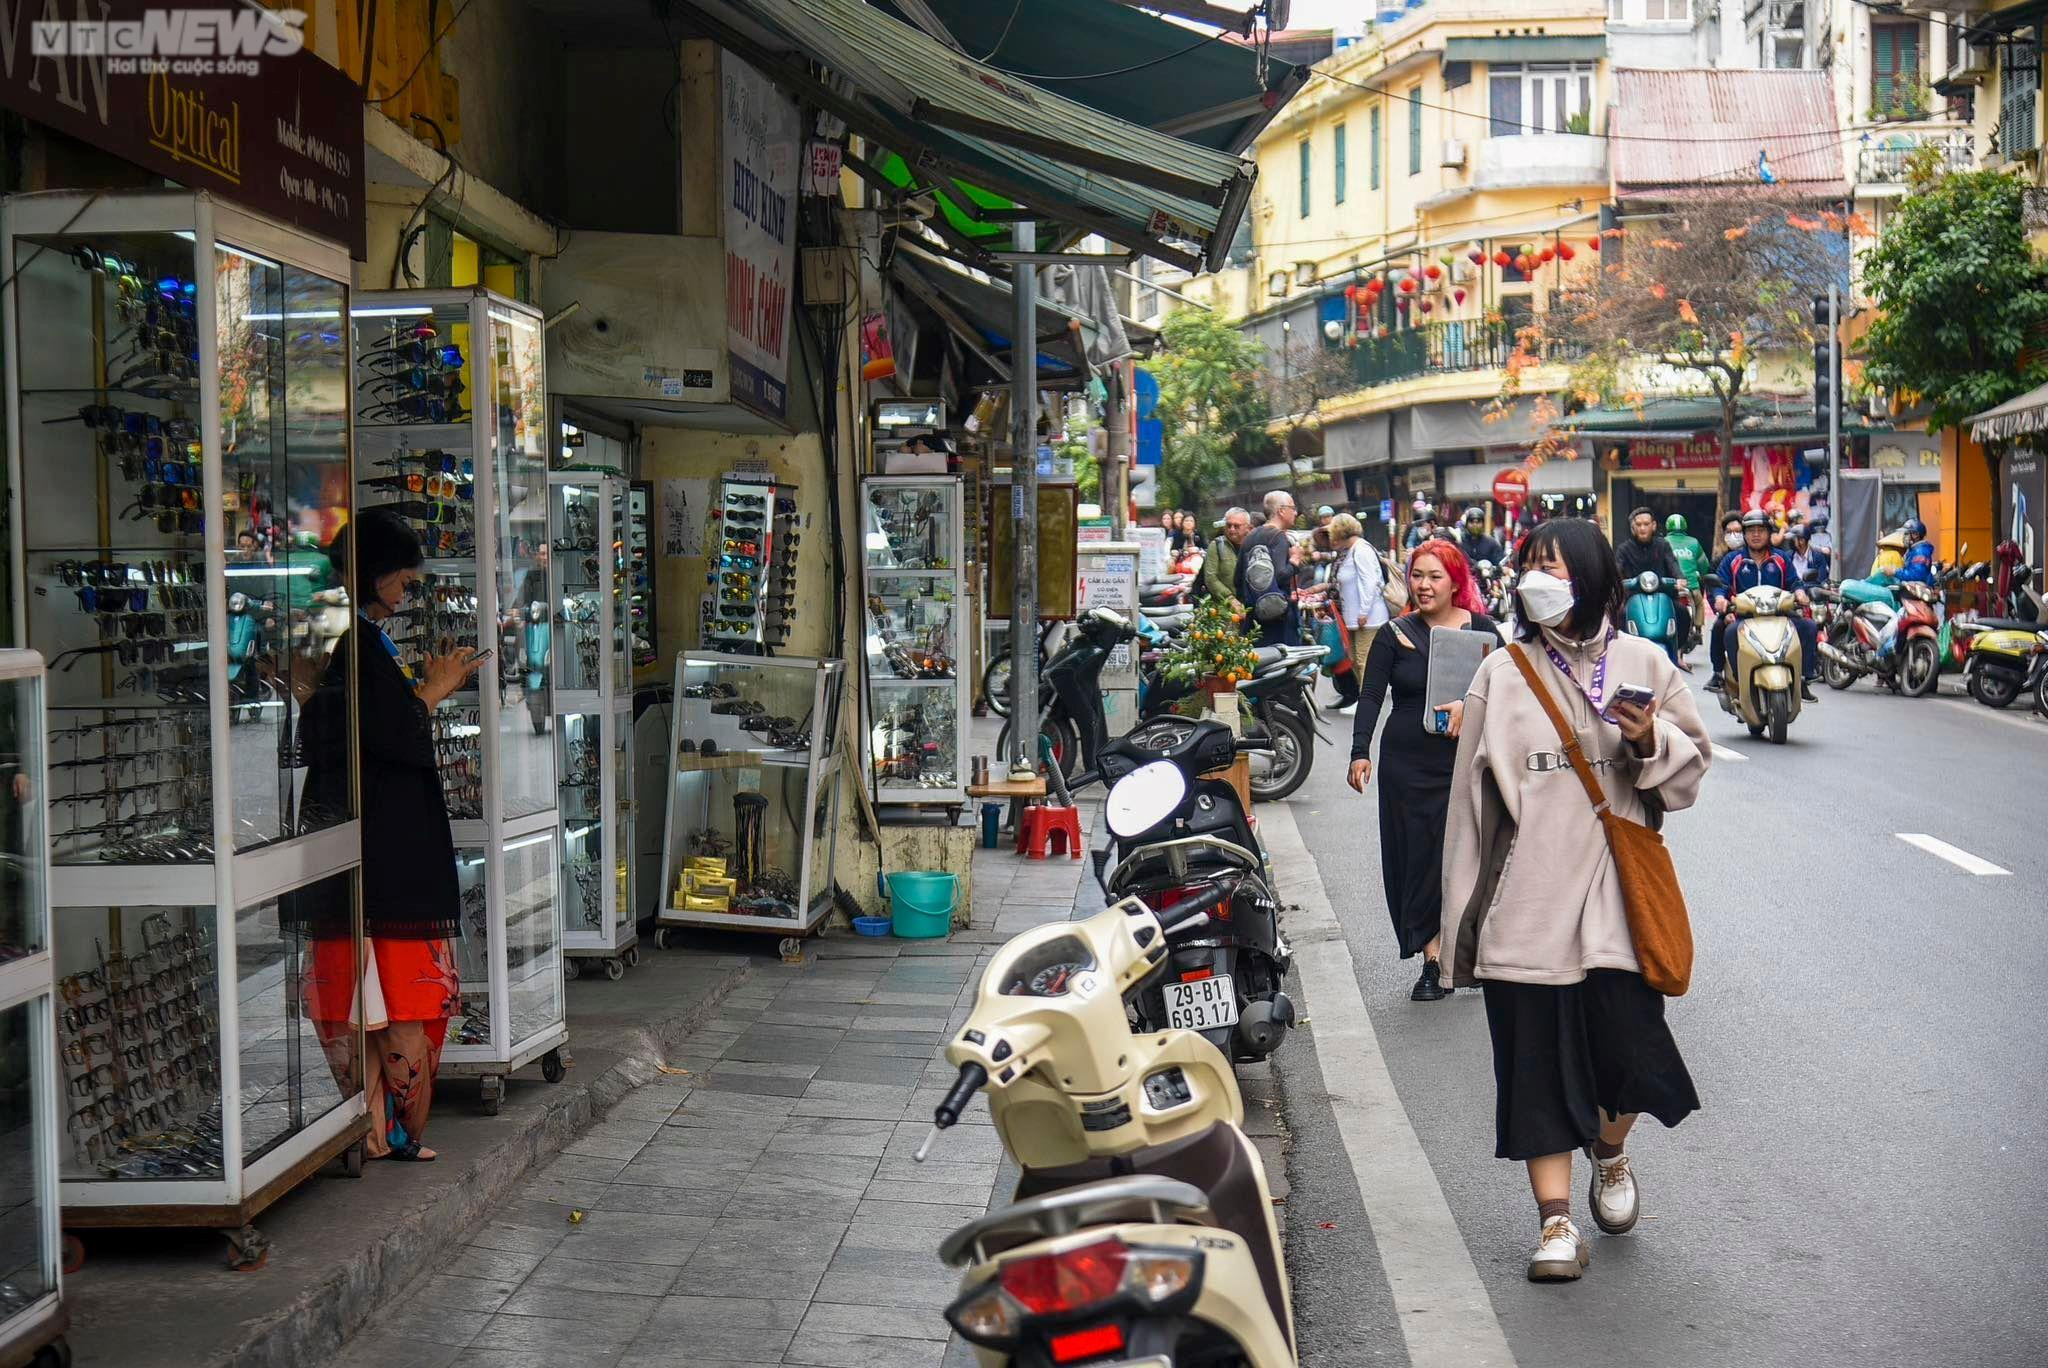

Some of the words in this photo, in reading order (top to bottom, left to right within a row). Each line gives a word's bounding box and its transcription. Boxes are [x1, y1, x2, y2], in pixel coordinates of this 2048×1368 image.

[149, 69, 241, 175] Optical
[733, 158, 758, 231] HIỆU
[760, 171, 786, 246] KÍNH
[727, 251, 755, 342] MINH
[758, 257, 786, 361] CHÂU
[1171, 1001, 1230, 1029] 693.17
[1172, 979, 1222, 1008] 29-B1
